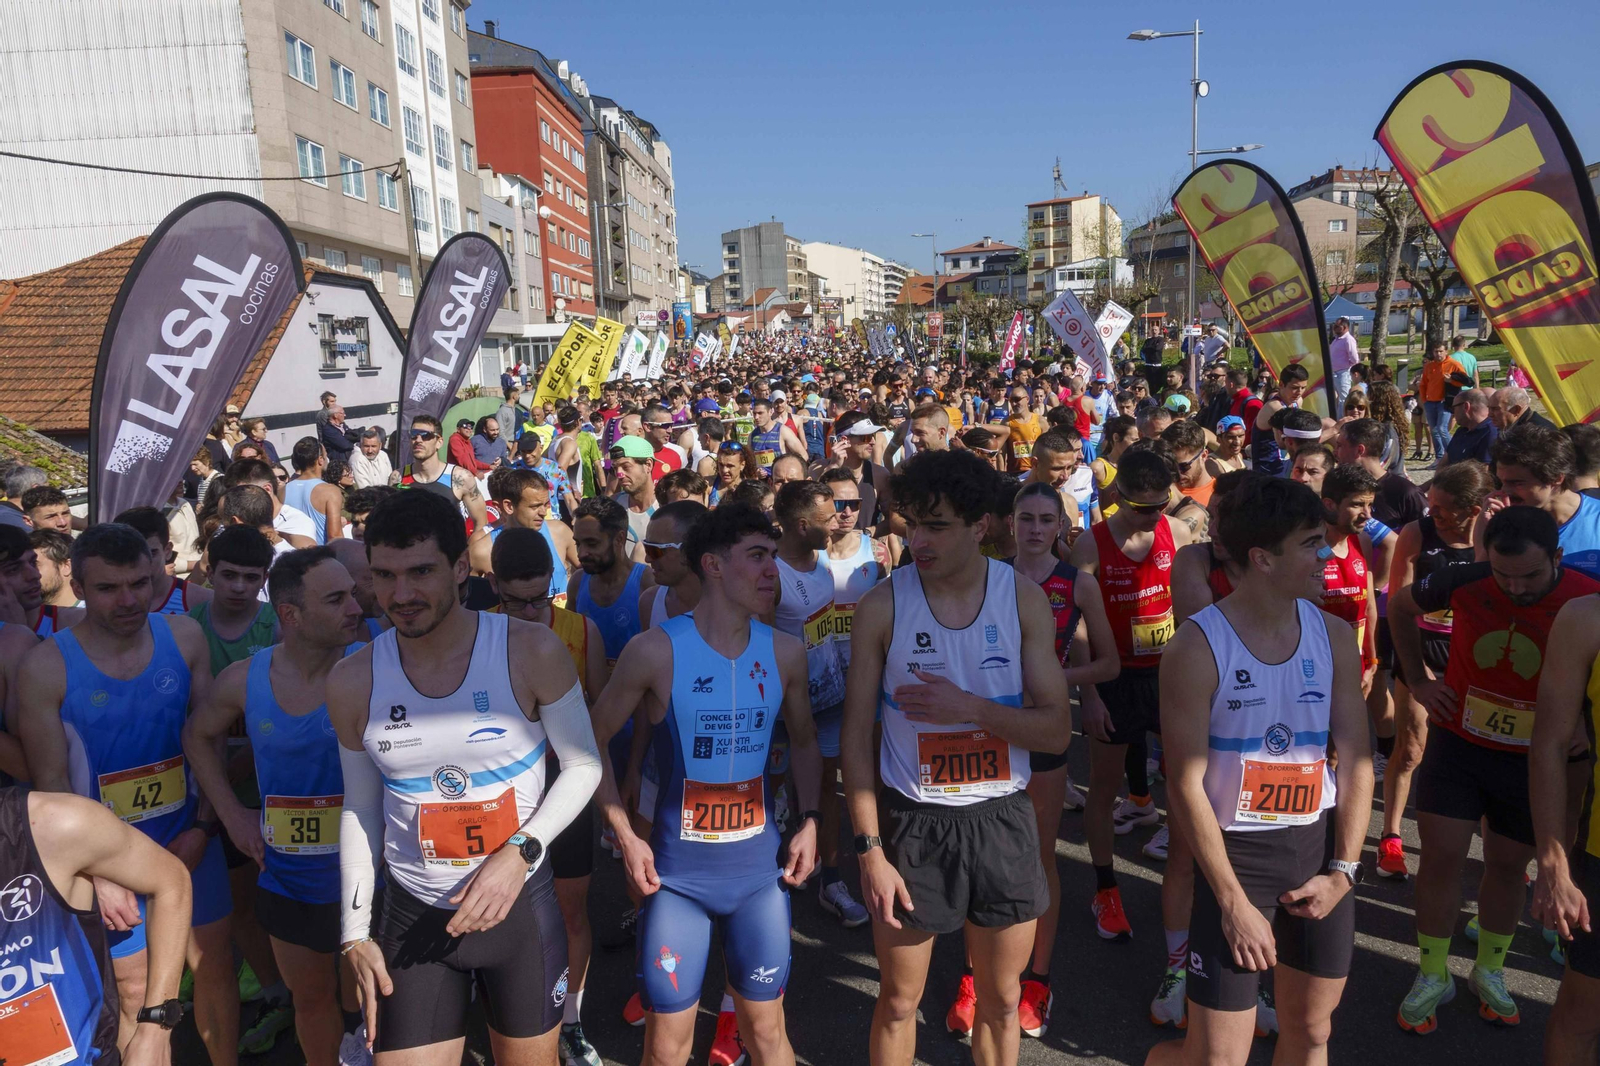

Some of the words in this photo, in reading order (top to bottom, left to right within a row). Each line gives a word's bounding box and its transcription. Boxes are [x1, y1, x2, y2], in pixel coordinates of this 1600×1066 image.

[239, 262, 279, 325] cocinas
[479, 269, 499, 310] cocinas
[421, 265, 489, 375] LASAL
[127, 253, 262, 429] LASAL
[546, 332, 588, 392] ELECPOR
[1020, 446, 1030, 455] 53
[1110, 594, 1116, 602] A
[1117, 584, 1165, 602] BOUTUREIRA
[692, 686, 713, 694] ZICO
[1233, 683, 1257, 691] austral
[700, 713, 746, 723] CONCELLO
[717, 721, 741, 730] VIGO
[1485, 710, 1516, 736] 45
[384, 722, 413, 731] austral
[393, 737, 422, 746] Deputación
[393, 741, 423, 750] Pontevedra
[716, 736, 751, 747] XUNTA
[715, 747, 729, 756] DE
[733, 743, 765, 754] GALICIA
[931, 750, 999, 784] 2003
[133, 775, 158, 785] MARCOS
[132, 781, 164, 810] 42
[1256, 783, 1315, 812] 2001
[458, 816, 488, 825] CARLOS
[694, 799, 755, 831] 2005
[290, 816, 321, 844] 39
[465, 825, 485, 855] 5
[750, 974, 774, 984] ZICO
